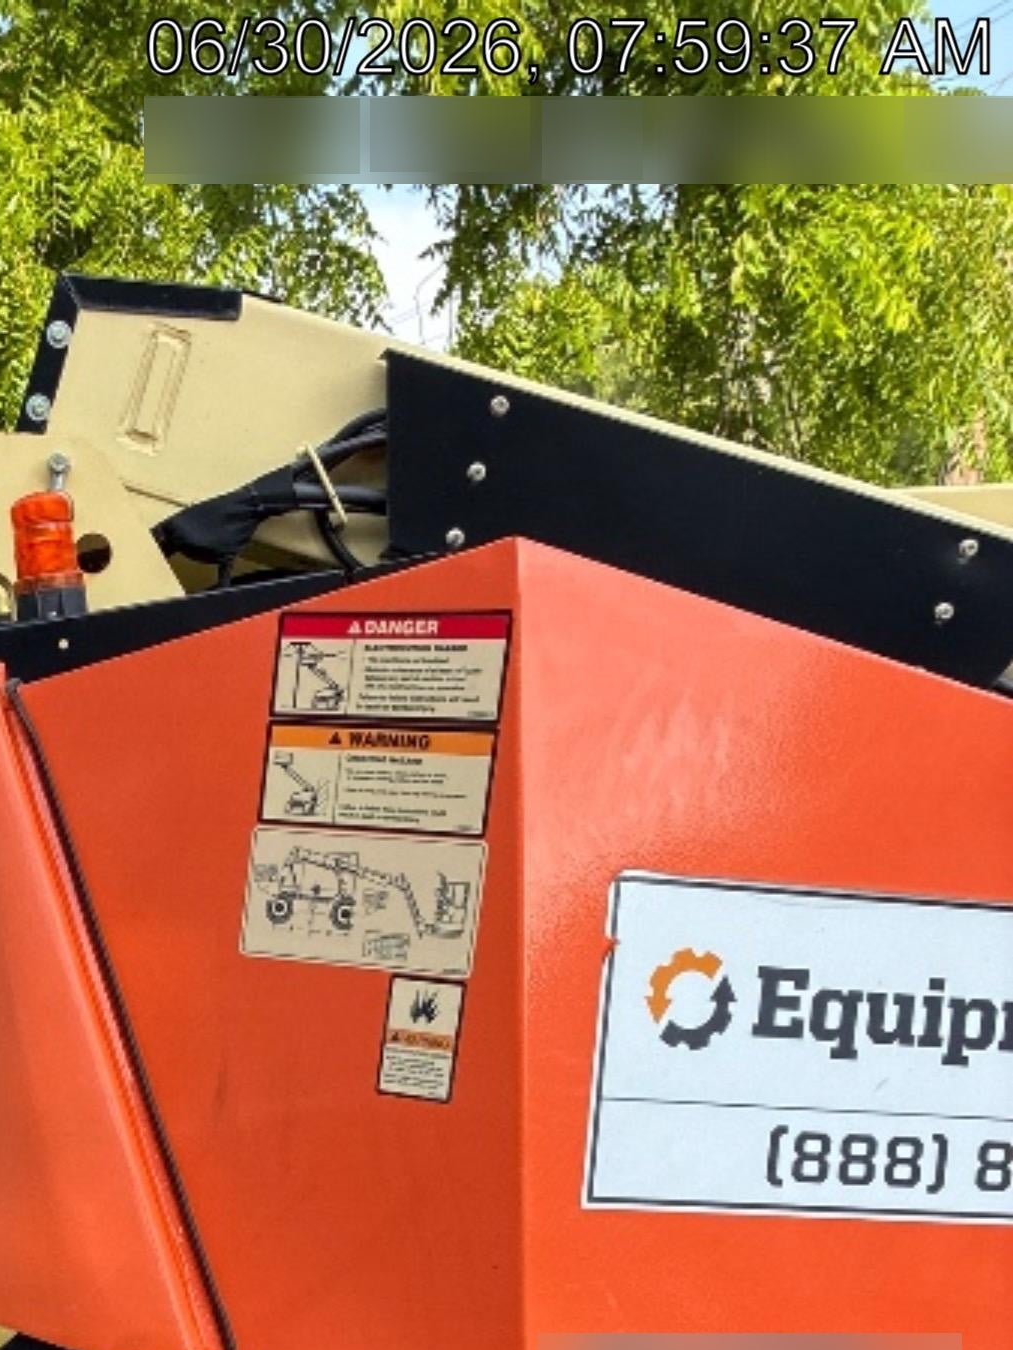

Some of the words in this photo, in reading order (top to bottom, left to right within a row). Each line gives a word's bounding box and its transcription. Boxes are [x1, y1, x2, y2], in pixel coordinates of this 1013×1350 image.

[365, 620, 438, 635] DANGER
[350, 731, 430, 749] WARNING
[766, 1125, 949, 1194] (888)
